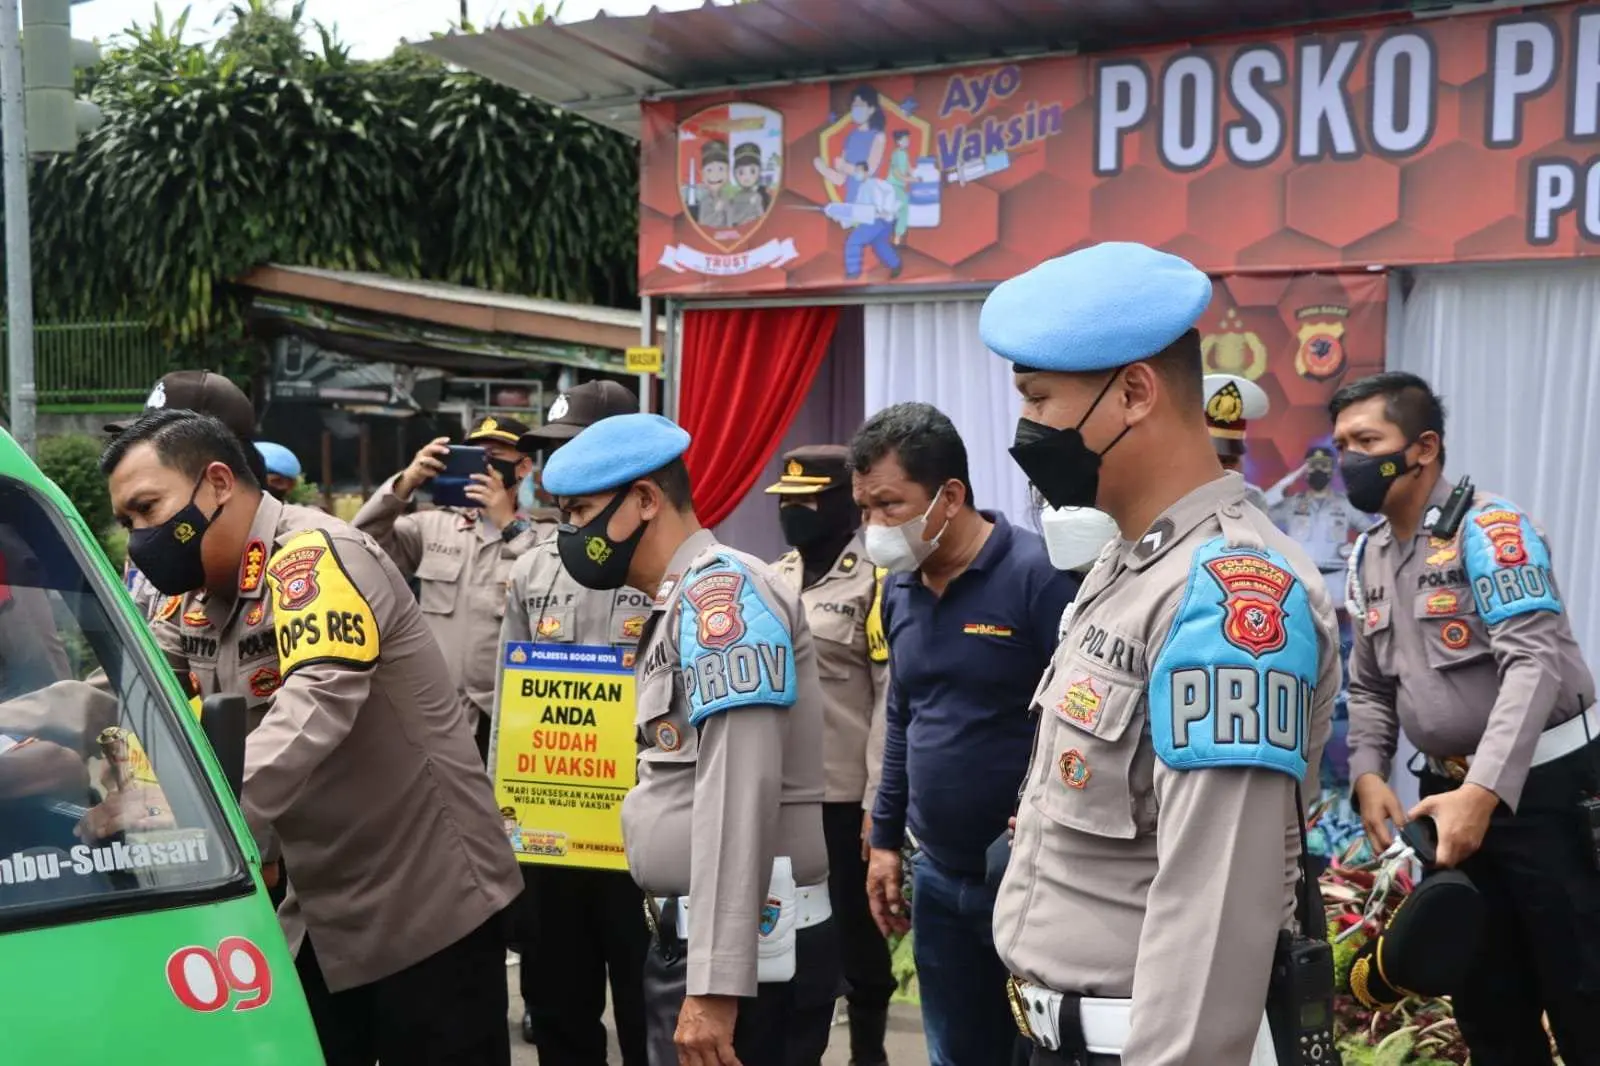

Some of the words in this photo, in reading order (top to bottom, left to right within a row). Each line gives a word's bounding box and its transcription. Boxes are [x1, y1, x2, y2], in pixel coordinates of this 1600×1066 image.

[938, 64, 1021, 117] Ayo
[1095, 31, 1435, 174] POSKO
[937, 101, 1062, 170] Vaksin
[705, 255, 749, 268] TRUST
[617, 594, 651, 607] POL
[813, 602, 855, 617] POLRI
[280, 613, 320, 658] OPS
[326, 610, 366, 646] RES
[531, 651, 568, 660] POLRESTA
[569, 652, 596, 662] BOGOR
[597, 654, 616, 663] KOTA
[1079, 624, 1135, 672] POLRI
[521, 678, 622, 702] BUKTIKAN
[682, 645, 786, 719] PROV
[540, 705, 596, 726] ANDA
[532, 729, 598, 752] SUDAH
[518, 753, 536, 773] DI
[544, 755, 616, 779] VAKSIN
[513, 795, 545, 805] WISATA
[548, 797, 576, 808] WAJIB
[531, 787, 581, 798] SUKSESKAN
[166, 936, 273, 1013] 09
